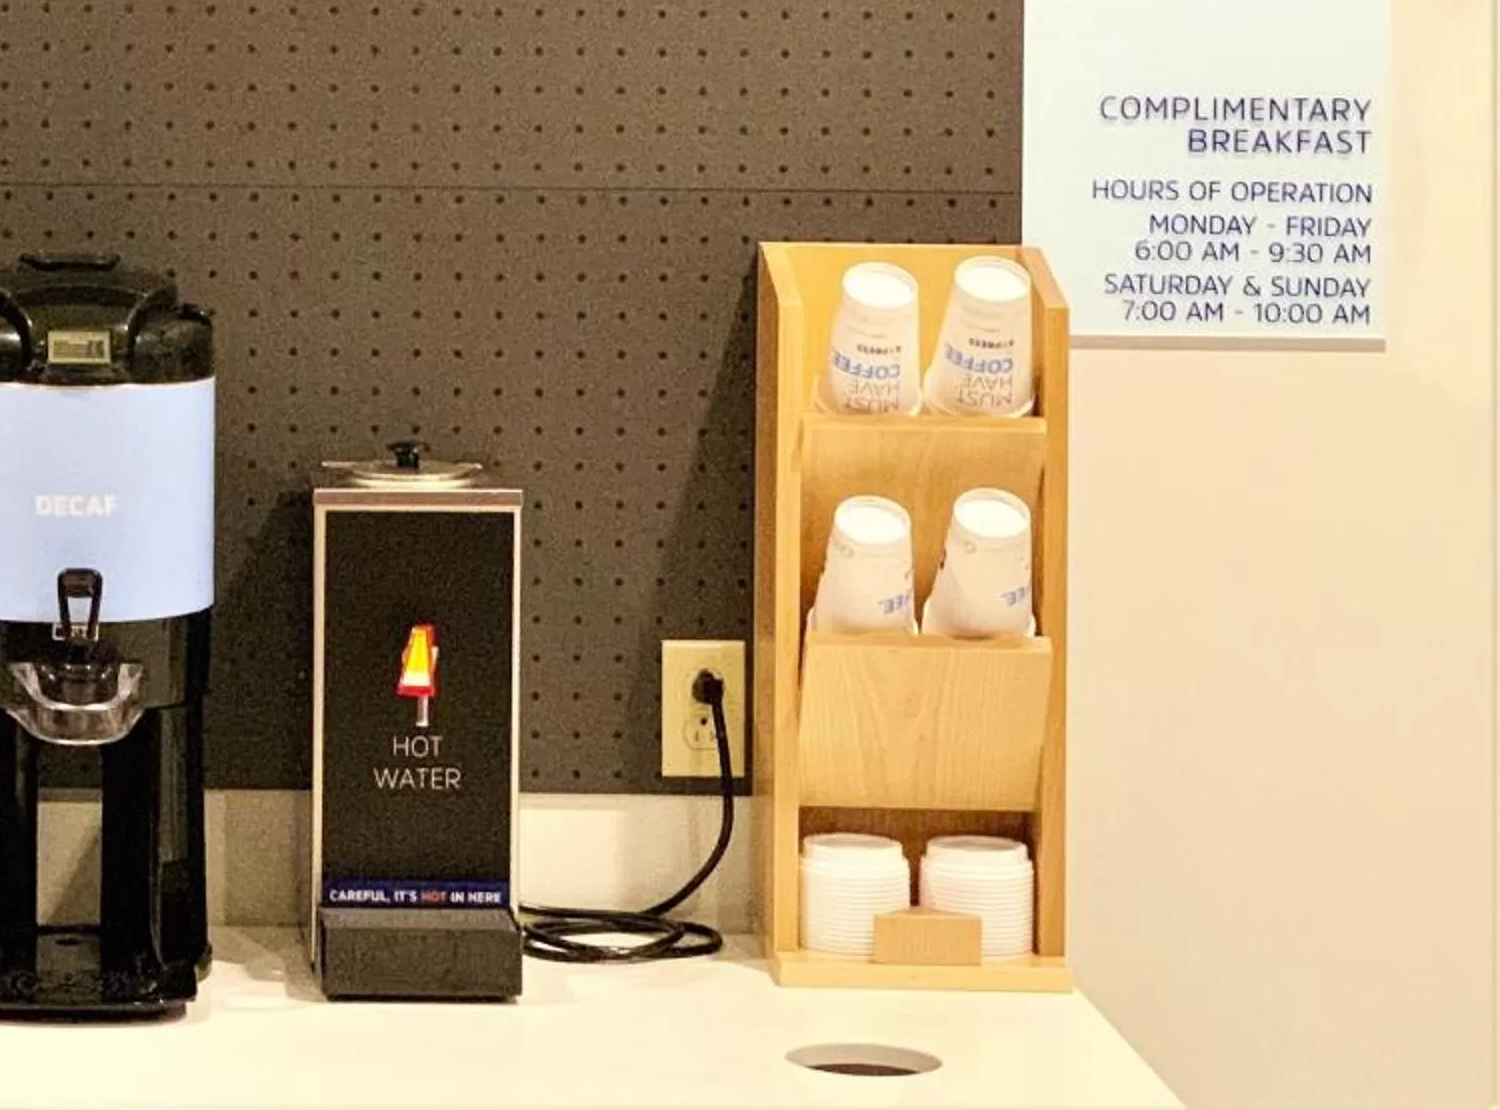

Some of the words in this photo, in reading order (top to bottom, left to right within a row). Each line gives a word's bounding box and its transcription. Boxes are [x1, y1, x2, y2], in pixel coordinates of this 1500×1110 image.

[1100, 95, 1372, 122] COMPLIMENTARY
[1188, 128, 1372, 154] BREAKFAST
[1092, 179, 1179, 200] HOURS
[1189, 180, 1221, 201] OF
[1231, 181, 1373, 203] OPERATION
[1150, 214, 1257, 235] MONDAY
[1286, 216, 1372, 237] FRIDAY
[1135, 240, 1193, 262] 6:00
[1202, 241, 1240, 262] AM
[1268, 242, 1324, 264] 9:30
[1333, 244, 1372, 264] AM
[1104, 273, 1233, 295] SATURDAY
[1243, 276, 1261, 297] &
[1271, 277, 1372, 298] SUNDAY
[1122, 299, 1177, 322] 7:00
[1186, 302, 1224, 322] AM
[1255, 302, 1323, 324] 10:00
[1332, 304, 1371, 324] AM
[35, 494, 118, 518] DECAF
[393, 736, 442, 758] HOT
[373, 767, 462, 790] WATER
[329, 889, 391, 903] CAREFUL,
[421, 890, 448, 903] HOT
[451, 891, 464, 903] IN
[467, 891, 501, 904] HERE
